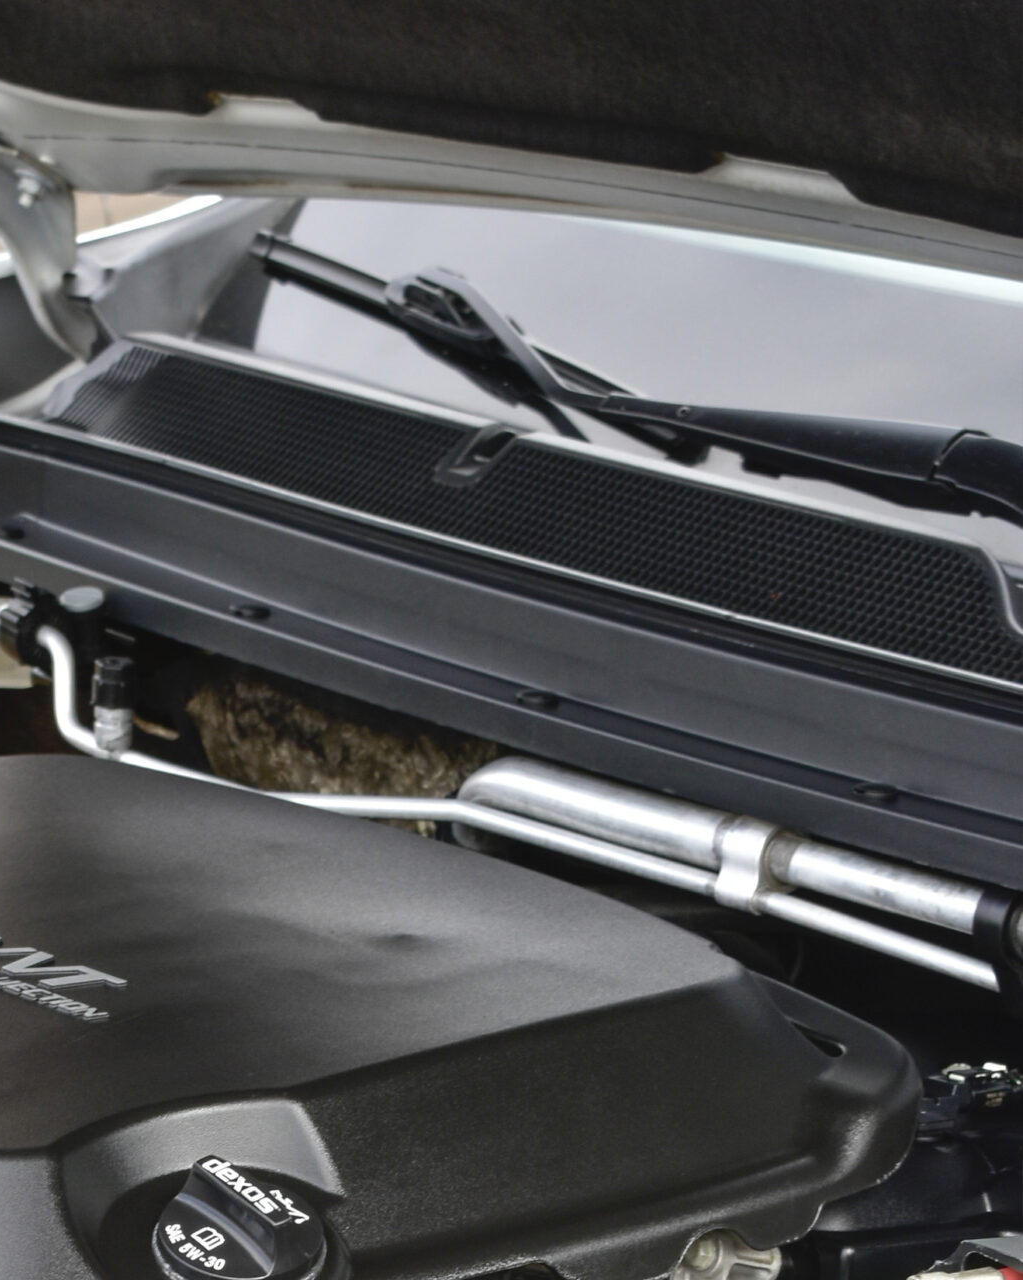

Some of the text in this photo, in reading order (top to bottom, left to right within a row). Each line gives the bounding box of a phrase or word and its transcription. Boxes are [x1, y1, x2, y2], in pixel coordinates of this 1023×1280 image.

[202, 1158, 279, 1215] dexos
[164, 1223, 226, 1271] SAE 5W-30
